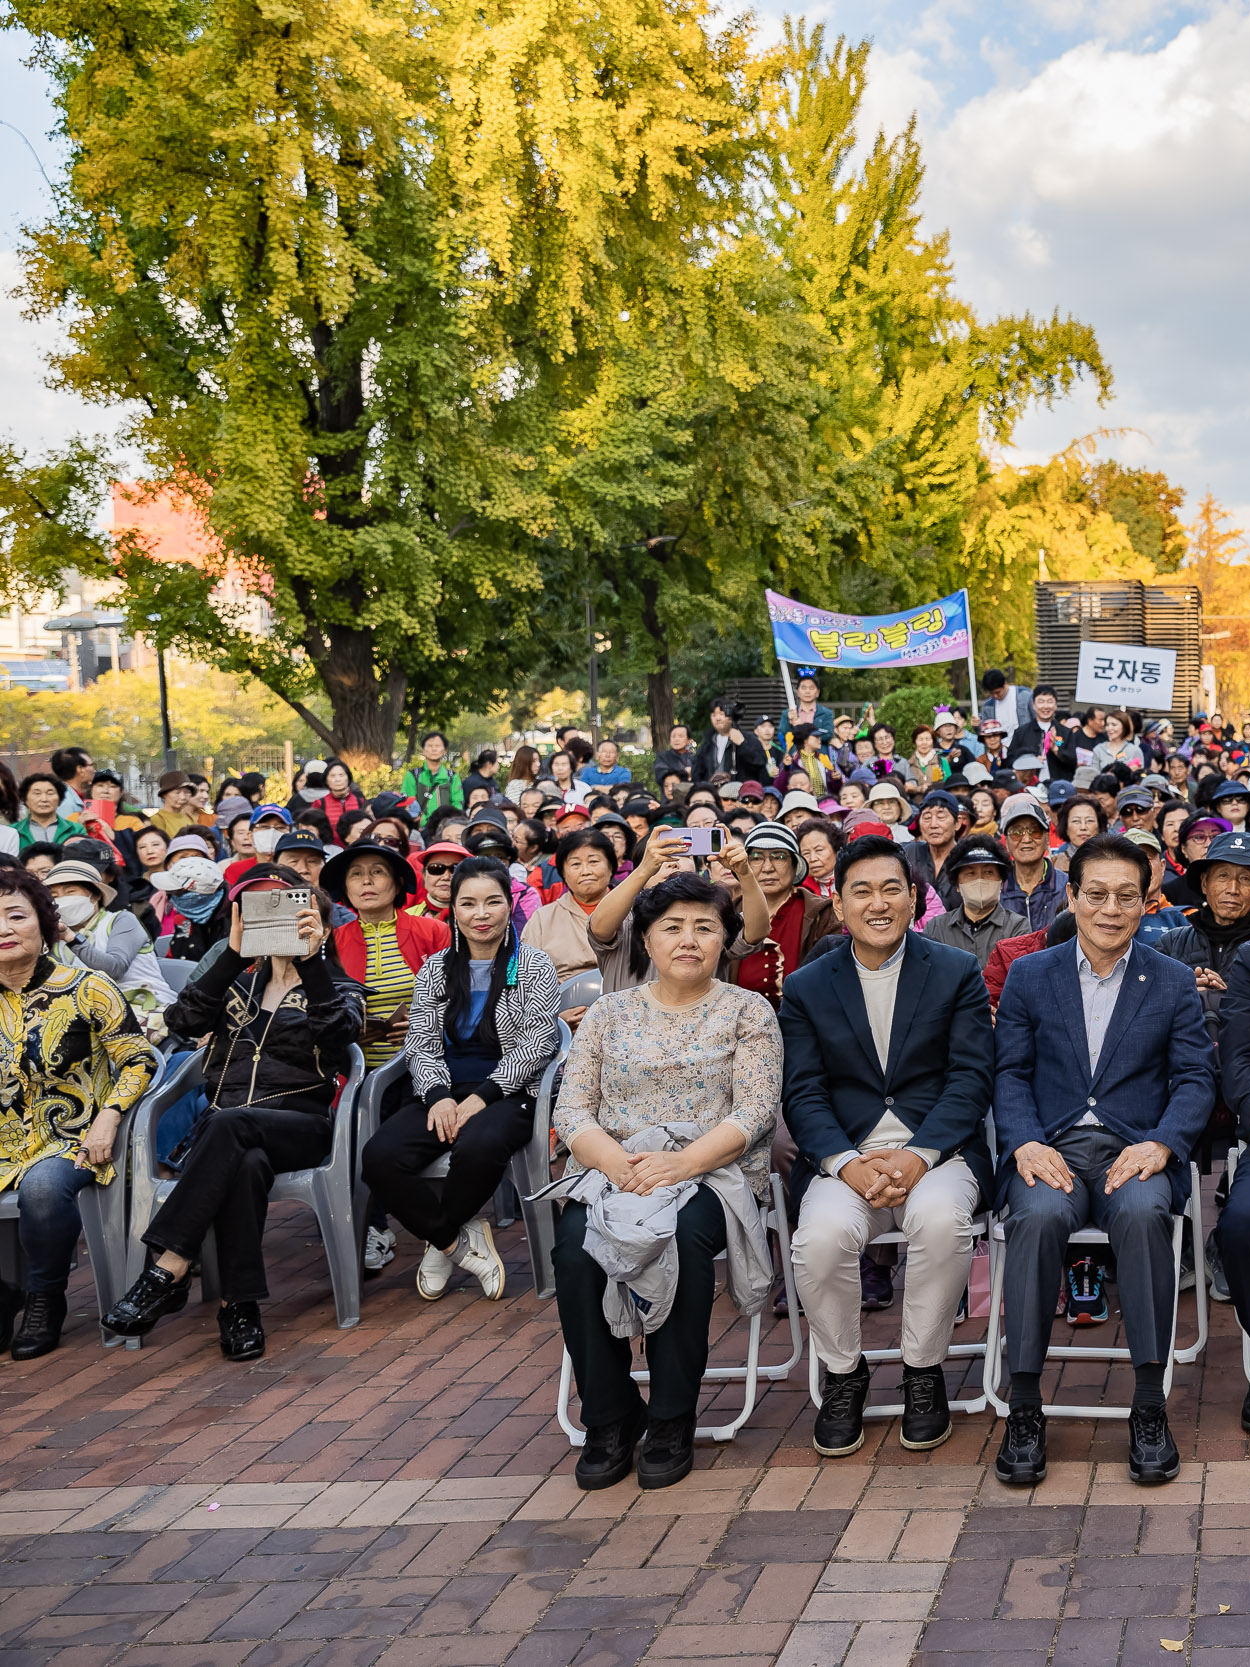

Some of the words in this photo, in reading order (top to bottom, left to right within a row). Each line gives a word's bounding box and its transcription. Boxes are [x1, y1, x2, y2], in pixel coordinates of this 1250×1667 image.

[809, 606, 944, 660] 블링블링
[1093, 656, 1162, 684] 군자동
[564, 803, 577, 814] N
